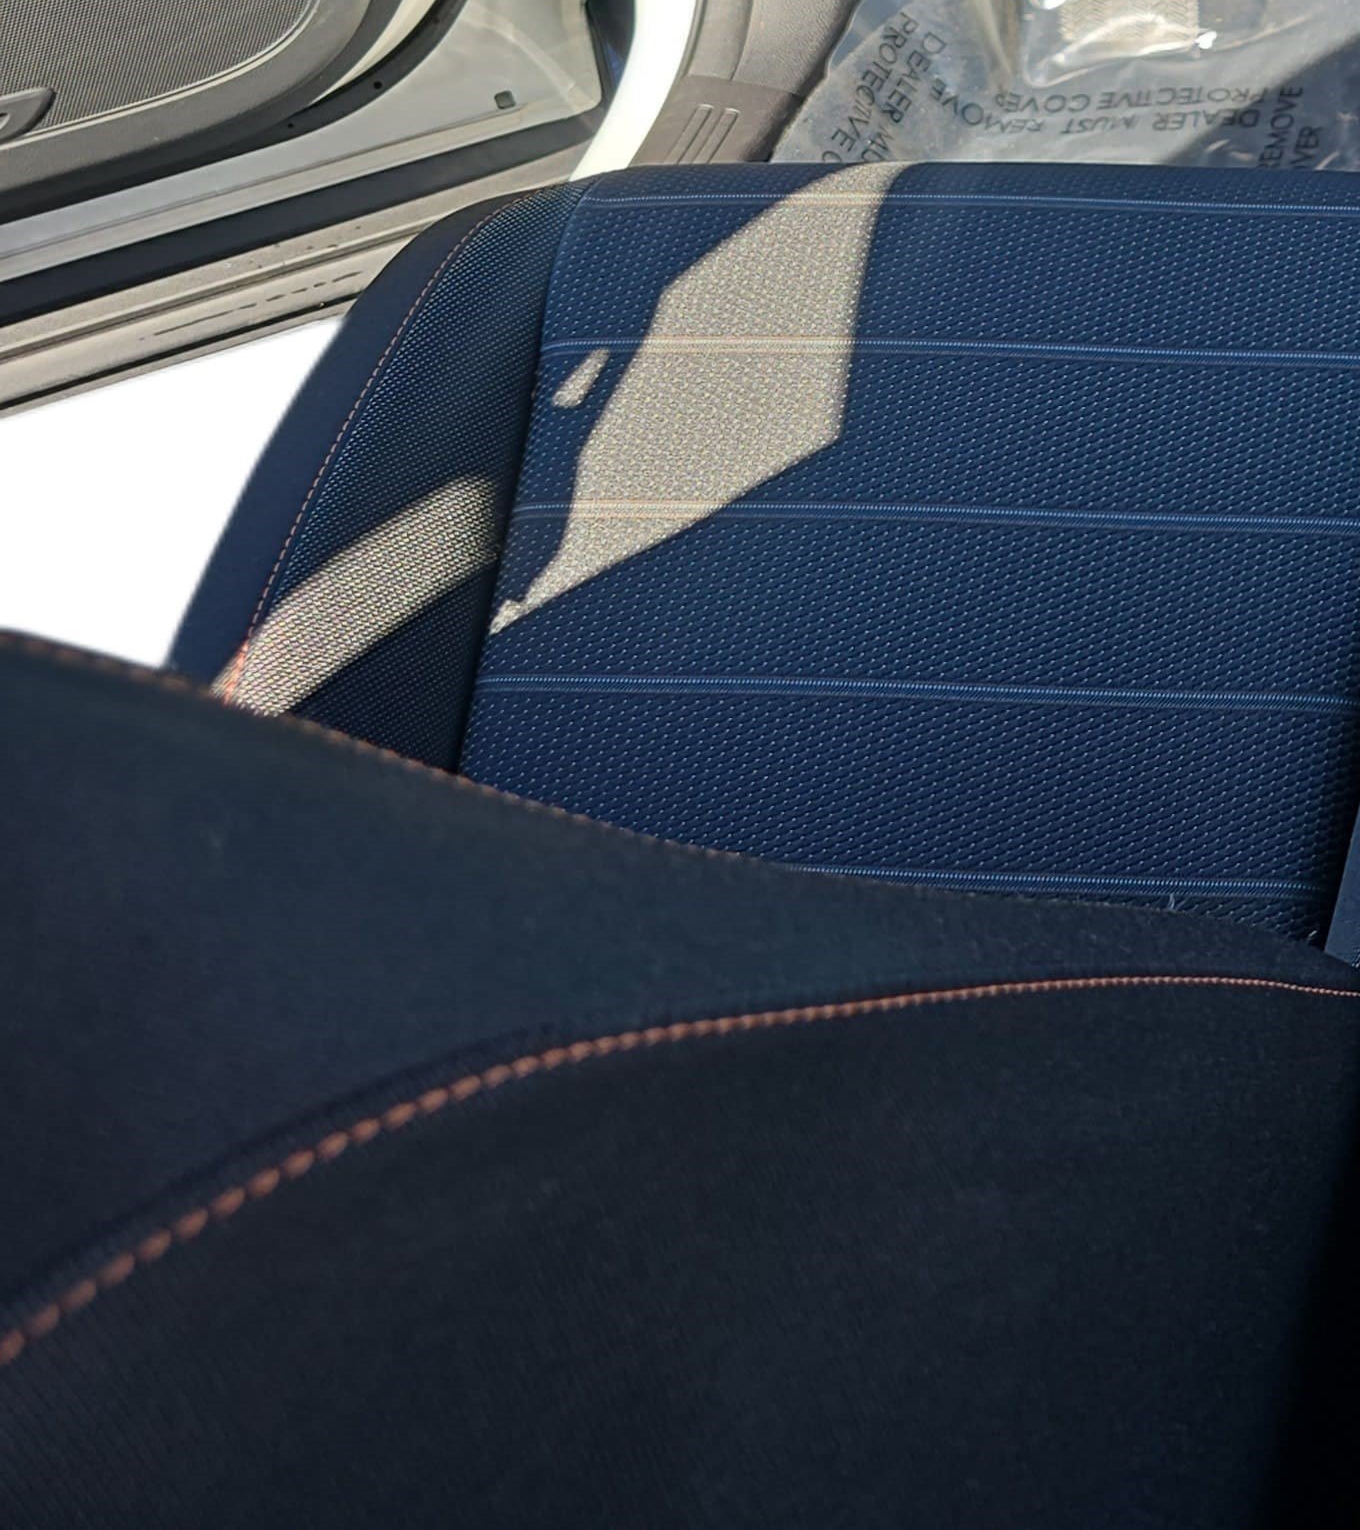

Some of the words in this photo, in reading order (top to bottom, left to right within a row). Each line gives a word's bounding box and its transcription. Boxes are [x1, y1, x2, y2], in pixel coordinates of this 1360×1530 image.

[831, 11, 920, 154] PROTECTIVE
[880, 32, 947, 125] DEALER
[1098, 84, 1270, 110] PROTECTIVE
[1060, 115, 1137, 135] MUST
[1151, 107, 1260, 133] DEALER
